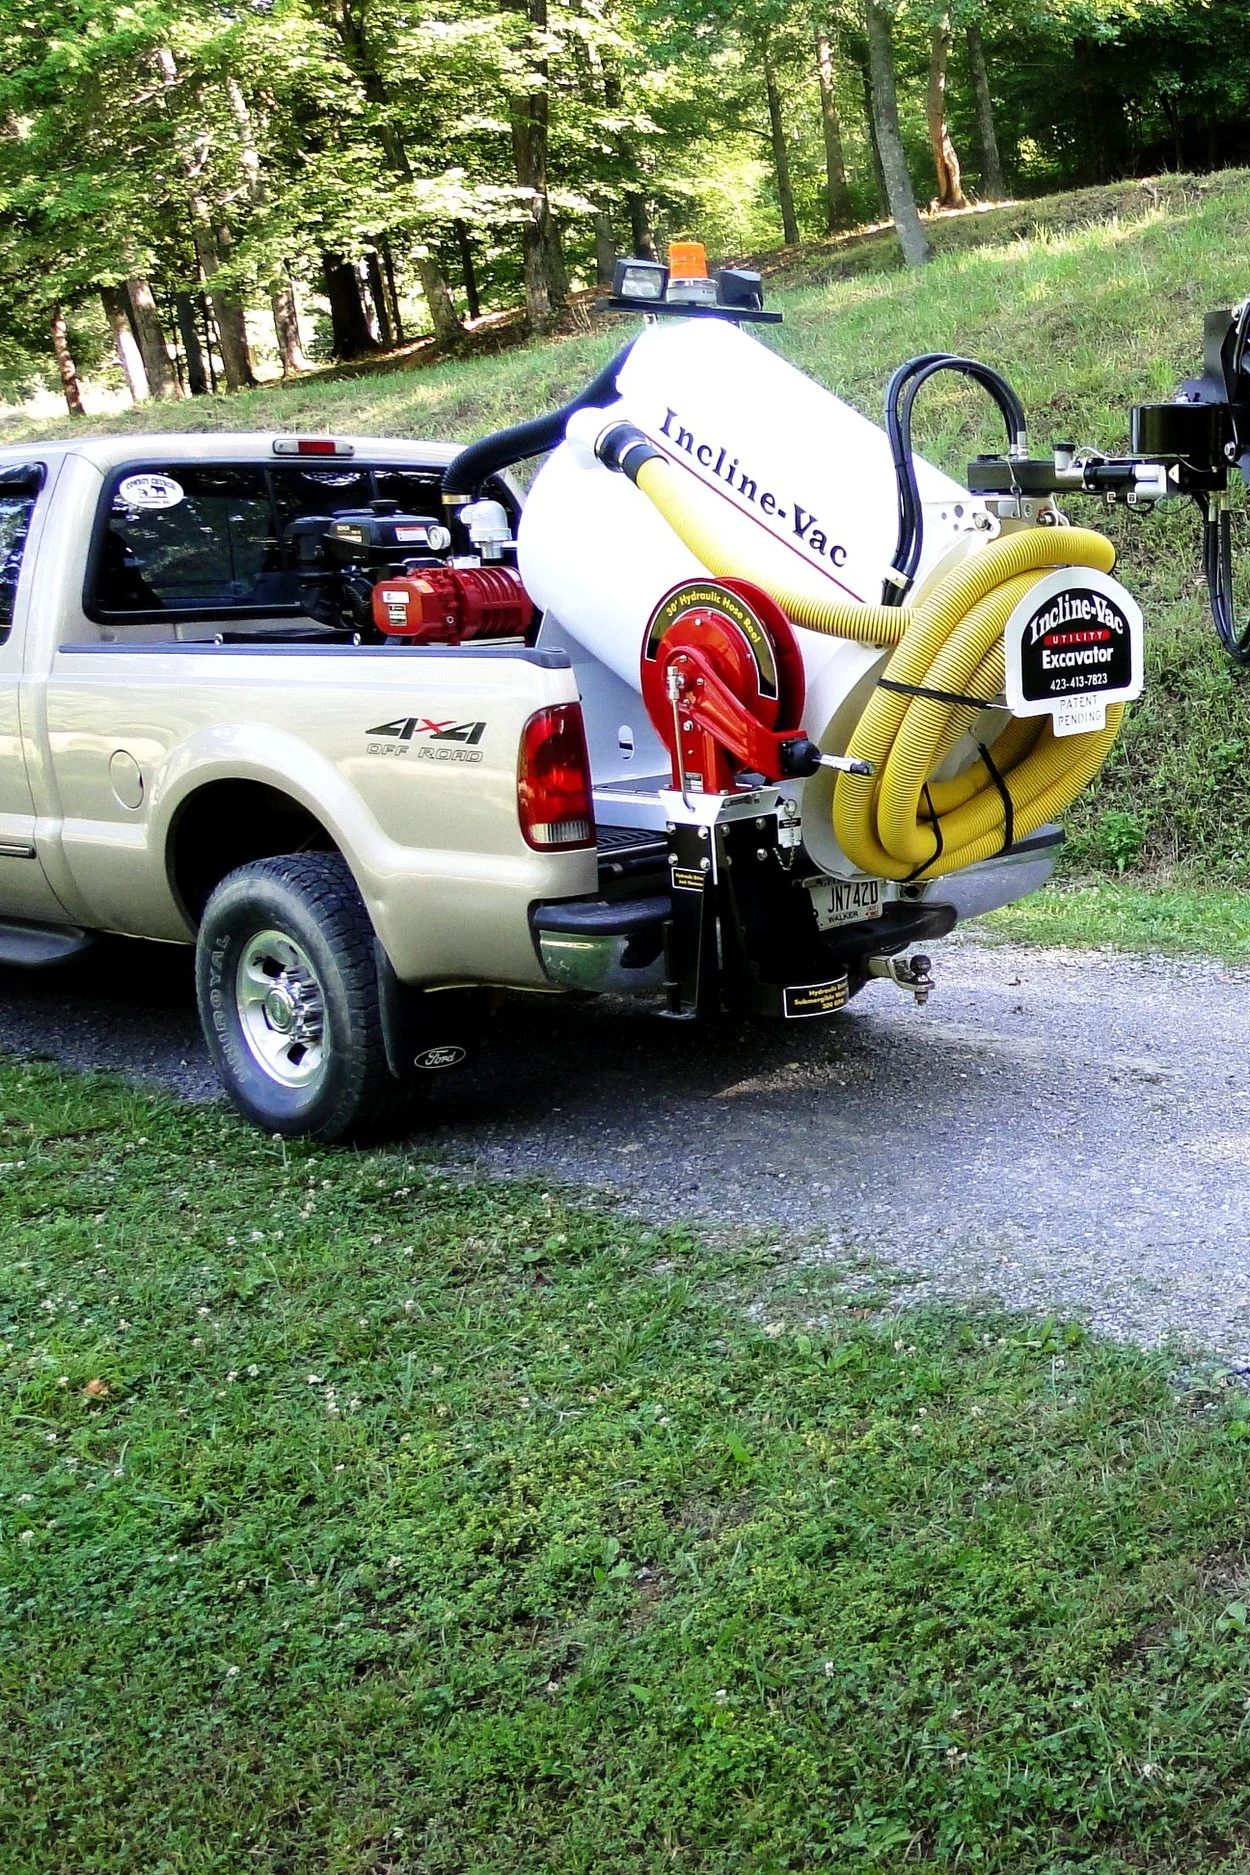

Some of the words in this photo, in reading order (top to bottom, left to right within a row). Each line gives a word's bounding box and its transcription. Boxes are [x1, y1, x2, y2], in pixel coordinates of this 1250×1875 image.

[658, 406, 848, 568] Incline-Vac
[679, 591, 721, 606] Hydraulic
[722, 596, 744, 619] Hose
[743, 617, 761, 644] Reel
[1030, 593, 1124, 645] Incline-Vac
[1052, 631, 1103, 644] UTILITY
[1042, 646, 1114, 669] Excavator
[1050, 673, 1108, 691] 423-413-7823
[1059, 694, 1098, 710] PATENT
[1058, 710, 1102, 727] PENDING
[367, 743, 410, 756] OFF
[418, 746, 484, 763] ROAD
[827, 910, 859, 923] WALKER
[209, 934, 248, 1083] UNIROYAL
[425, 1049, 457, 1066] Ford
